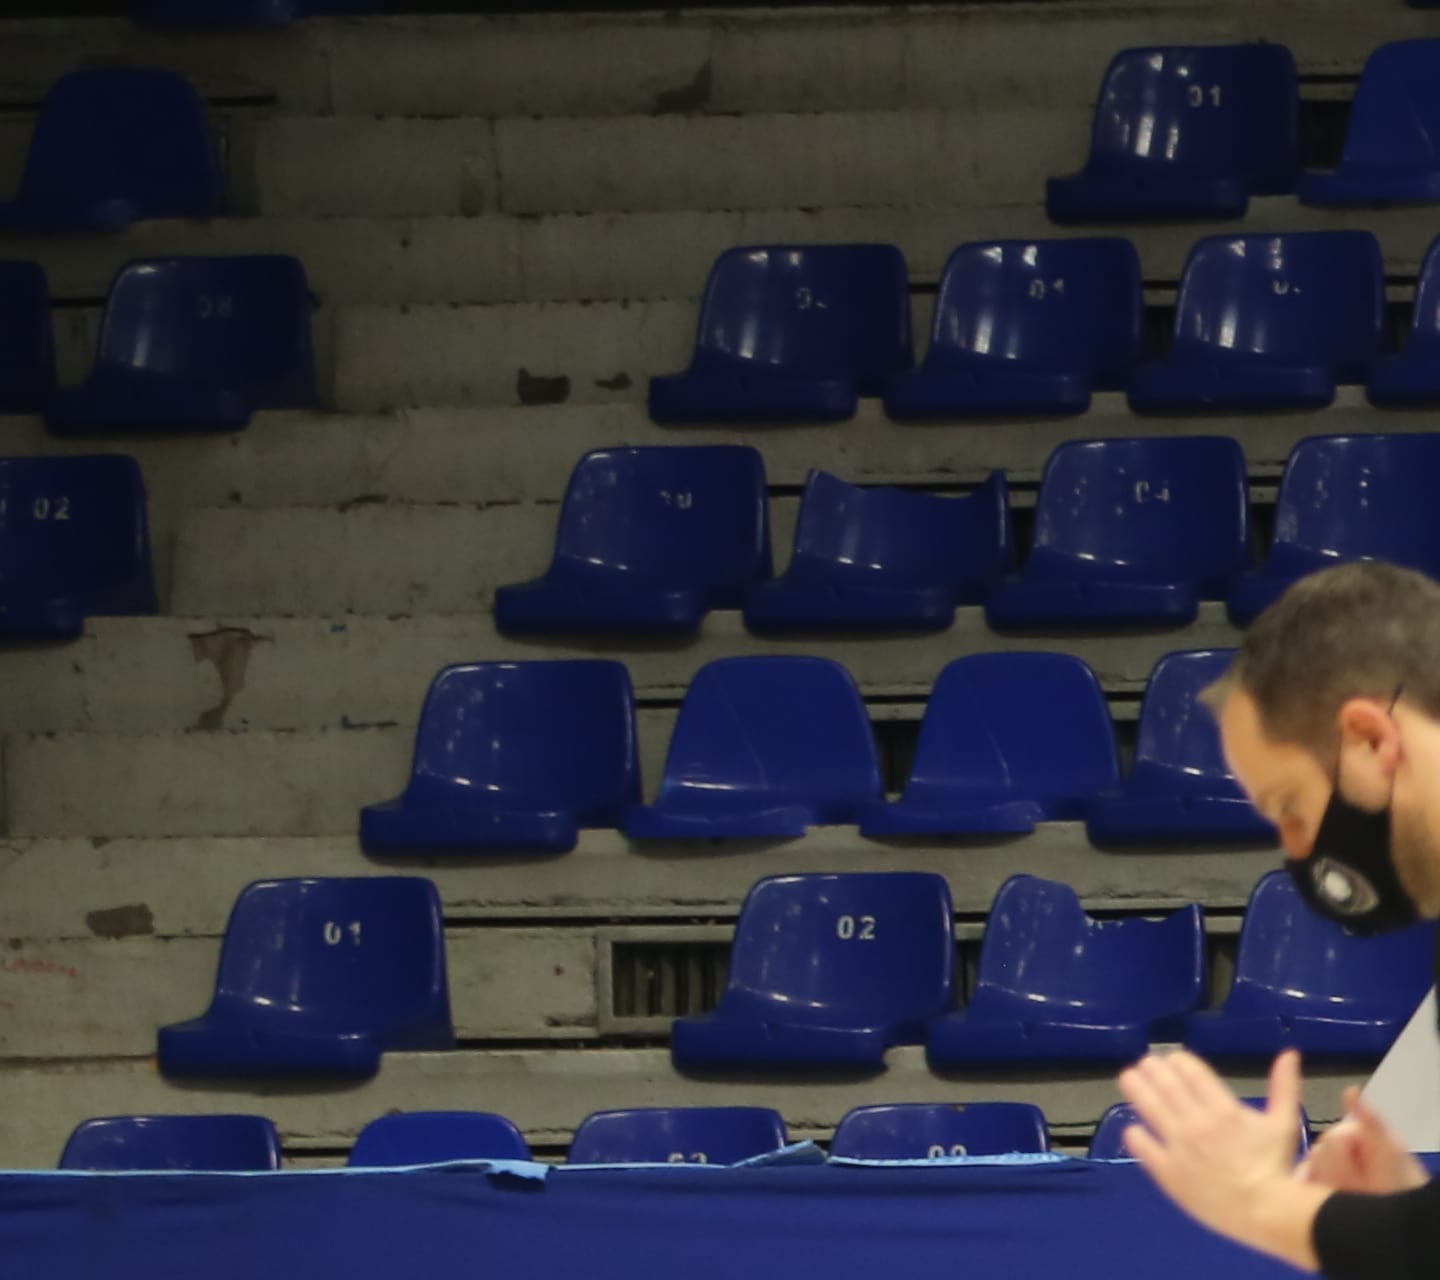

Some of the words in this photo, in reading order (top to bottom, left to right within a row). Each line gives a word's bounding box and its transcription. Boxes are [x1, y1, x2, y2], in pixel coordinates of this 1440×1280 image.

[32, 496, 70, 522] 02
[323, 919, 362, 946] 01
[836, 914, 876, 941] 02
